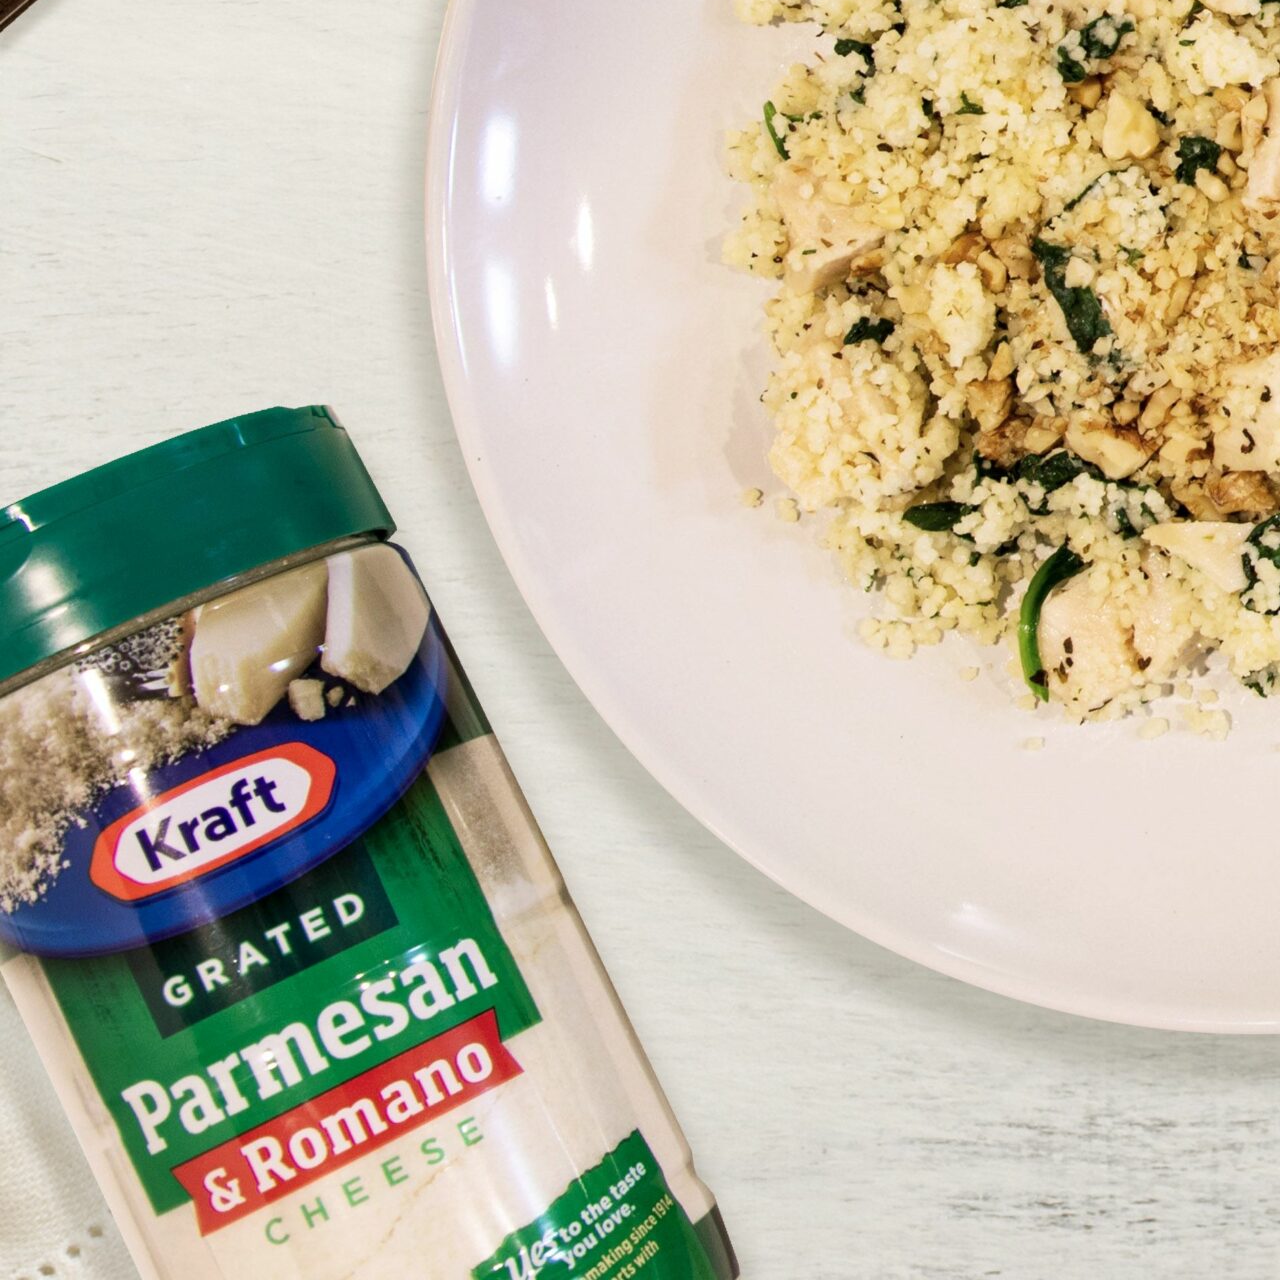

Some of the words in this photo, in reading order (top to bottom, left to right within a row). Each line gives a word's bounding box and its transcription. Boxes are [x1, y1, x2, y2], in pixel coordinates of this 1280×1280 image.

[135, 775, 287, 872] Kraft
[162, 892, 366, 1007] GRATED
[121, 937, 499, 1156] Parmesan
[203, 1167, 247, 1213] &
[240, 1042, 494, 1194] Romano
[264, 1117, 484, 1245] CHEESE
[558, 1221, 582, 1243] to
[580, 1195, 613, 1225] the
[609, 1161, 647, 1200] taste
[629, 1214, 658, 1245] since
[651, 1193, 673, 1218] 1914
[558, 1232, 598, 1270] you
[594, 1203, 636, 1239] love.
[633, 1240, 659, 1268] with
